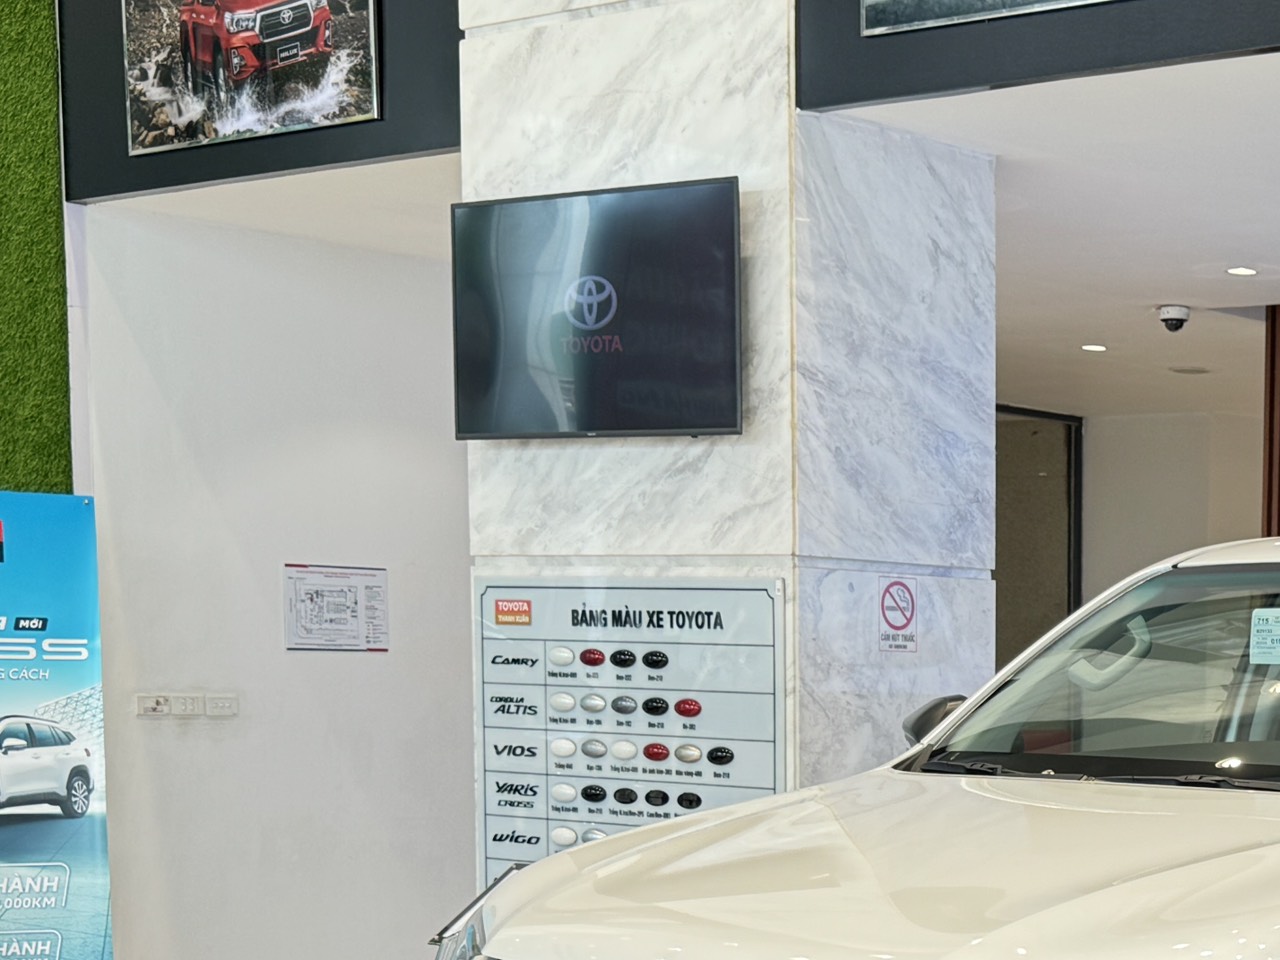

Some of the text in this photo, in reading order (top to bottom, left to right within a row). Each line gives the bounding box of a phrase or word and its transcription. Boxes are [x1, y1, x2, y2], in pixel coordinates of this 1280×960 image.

[560, 335, 624, 355] TOYOTA
[497, 601, 529, 611] TOYOTA
[571, 602, 724, 630] BẢNG MÀU XE TOYOTA
[1256, 617, 1270, 625] 715
[19, 618, 43, 629] MỚI
[9, 666, 49, 681] CÁCH
[494, 704, 538, 716] ALTIS
[493, 744, 538, 757] VIOS
[495, 781, 539, 797] YARIS
[497, 799, 534, 808] CROSS
